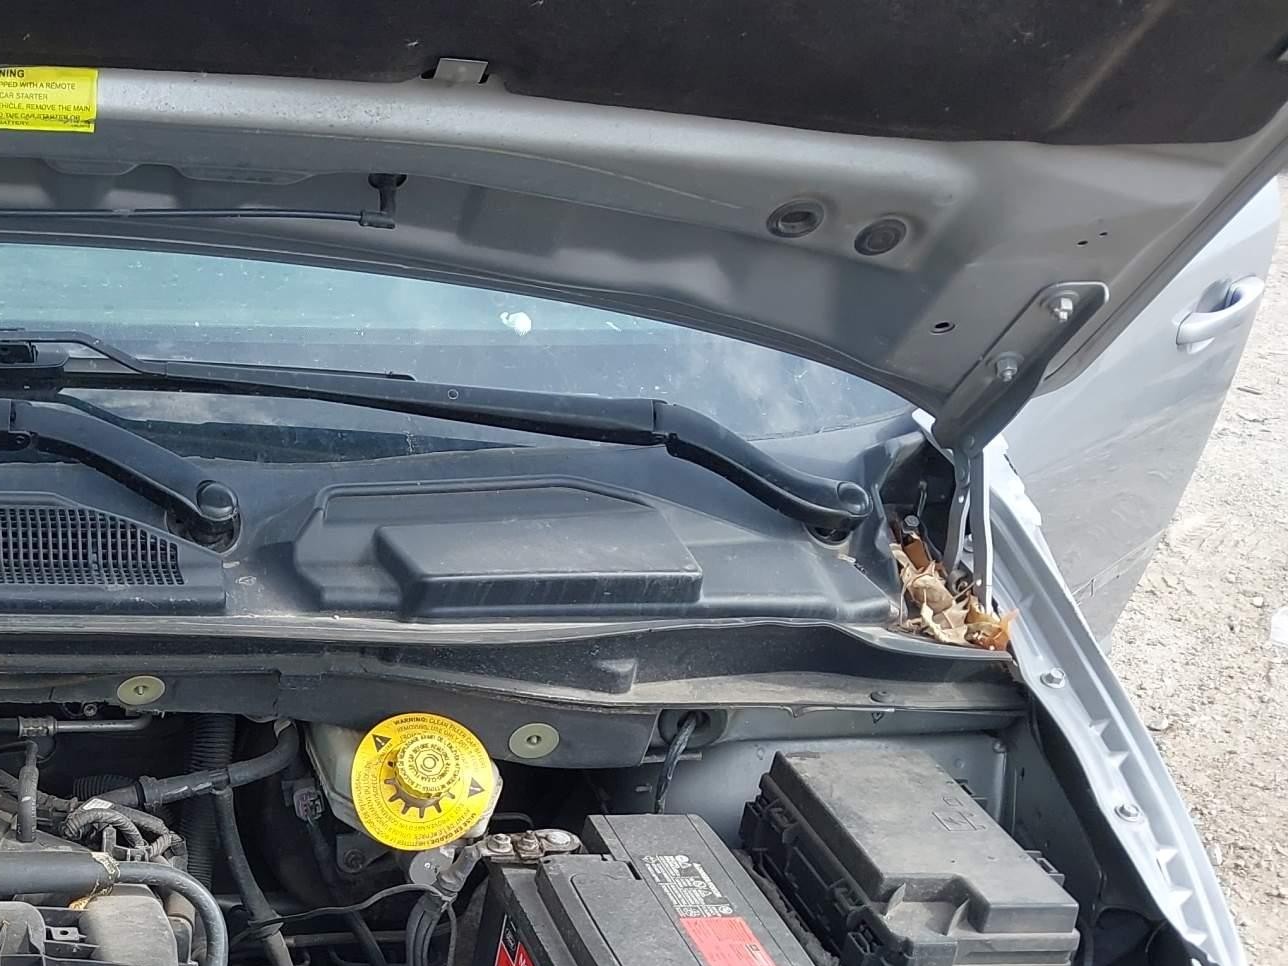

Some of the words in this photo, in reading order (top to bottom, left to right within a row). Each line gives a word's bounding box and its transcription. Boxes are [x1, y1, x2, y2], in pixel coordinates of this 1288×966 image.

[20, 81, 37, 89] WITH
[39, 81, 45, 89] A
[46, 82, 76, 90] REMOTE
[0, 91, 15, 99] CAR
[16, 92, 48, 100] STARTER
[25, 102, 57, 111] REMOVE
[58, 103, 72, 111] THE
[72, 104, 91, 112] MAIN
